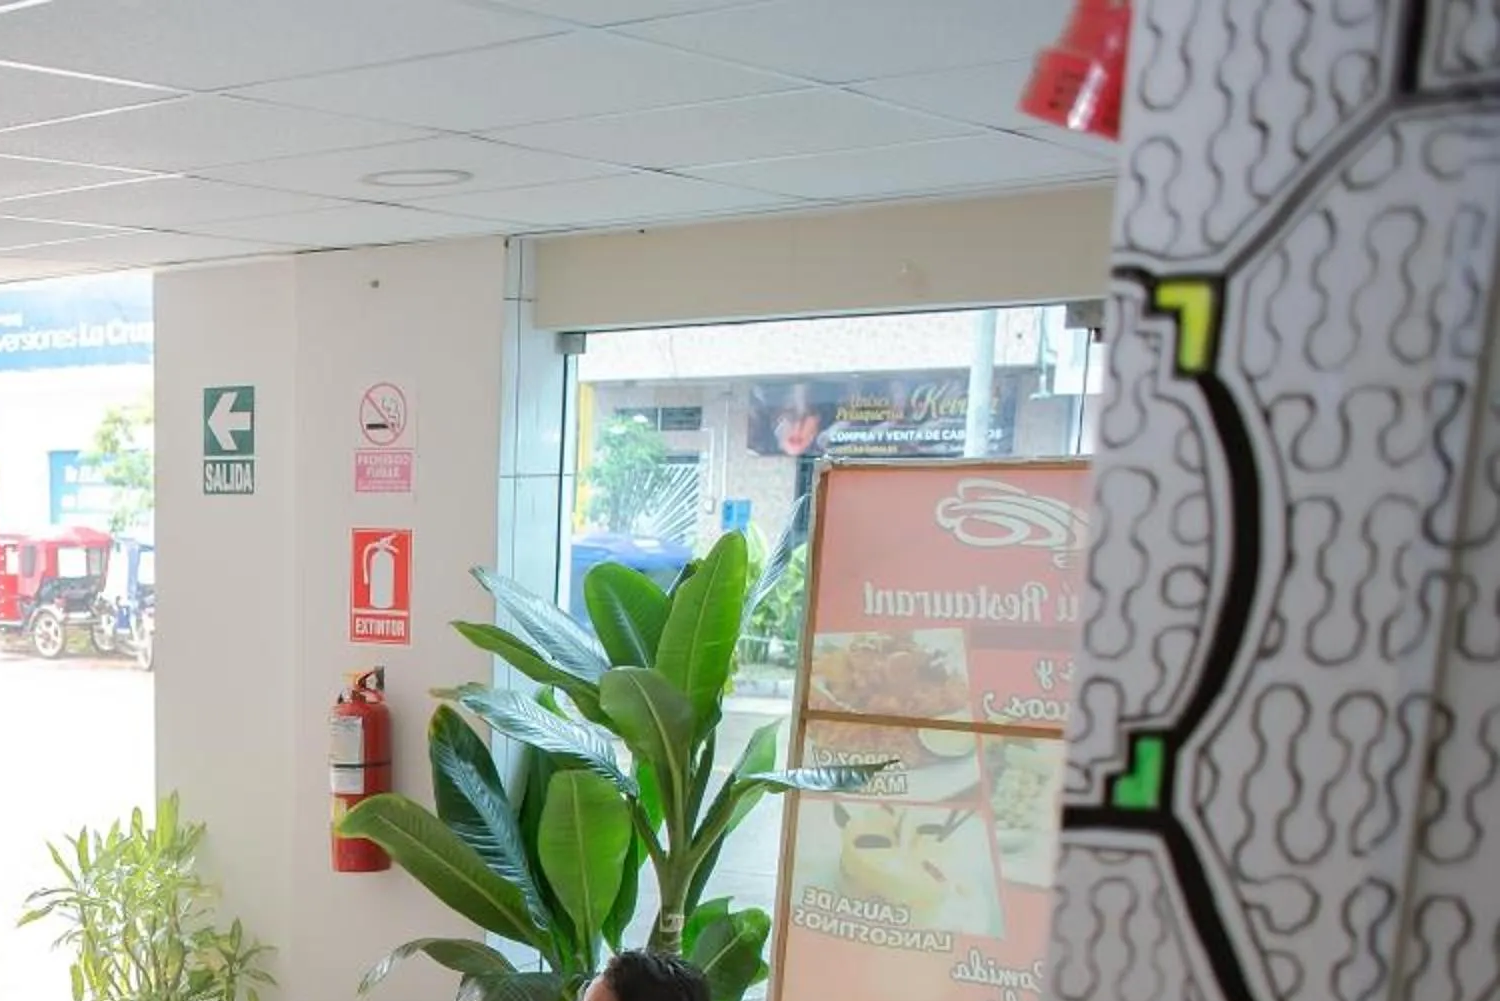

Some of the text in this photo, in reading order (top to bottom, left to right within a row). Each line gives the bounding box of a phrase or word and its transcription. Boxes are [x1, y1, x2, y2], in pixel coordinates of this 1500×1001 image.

[886, 428, 924, 442] VENTA
[924, 428, 941, 441] DE
[942, 428, 1003, 441] CABOS
[205, 462, 253, 493] SALIDA
[355, 616, 405, 637] EXTINTOR
